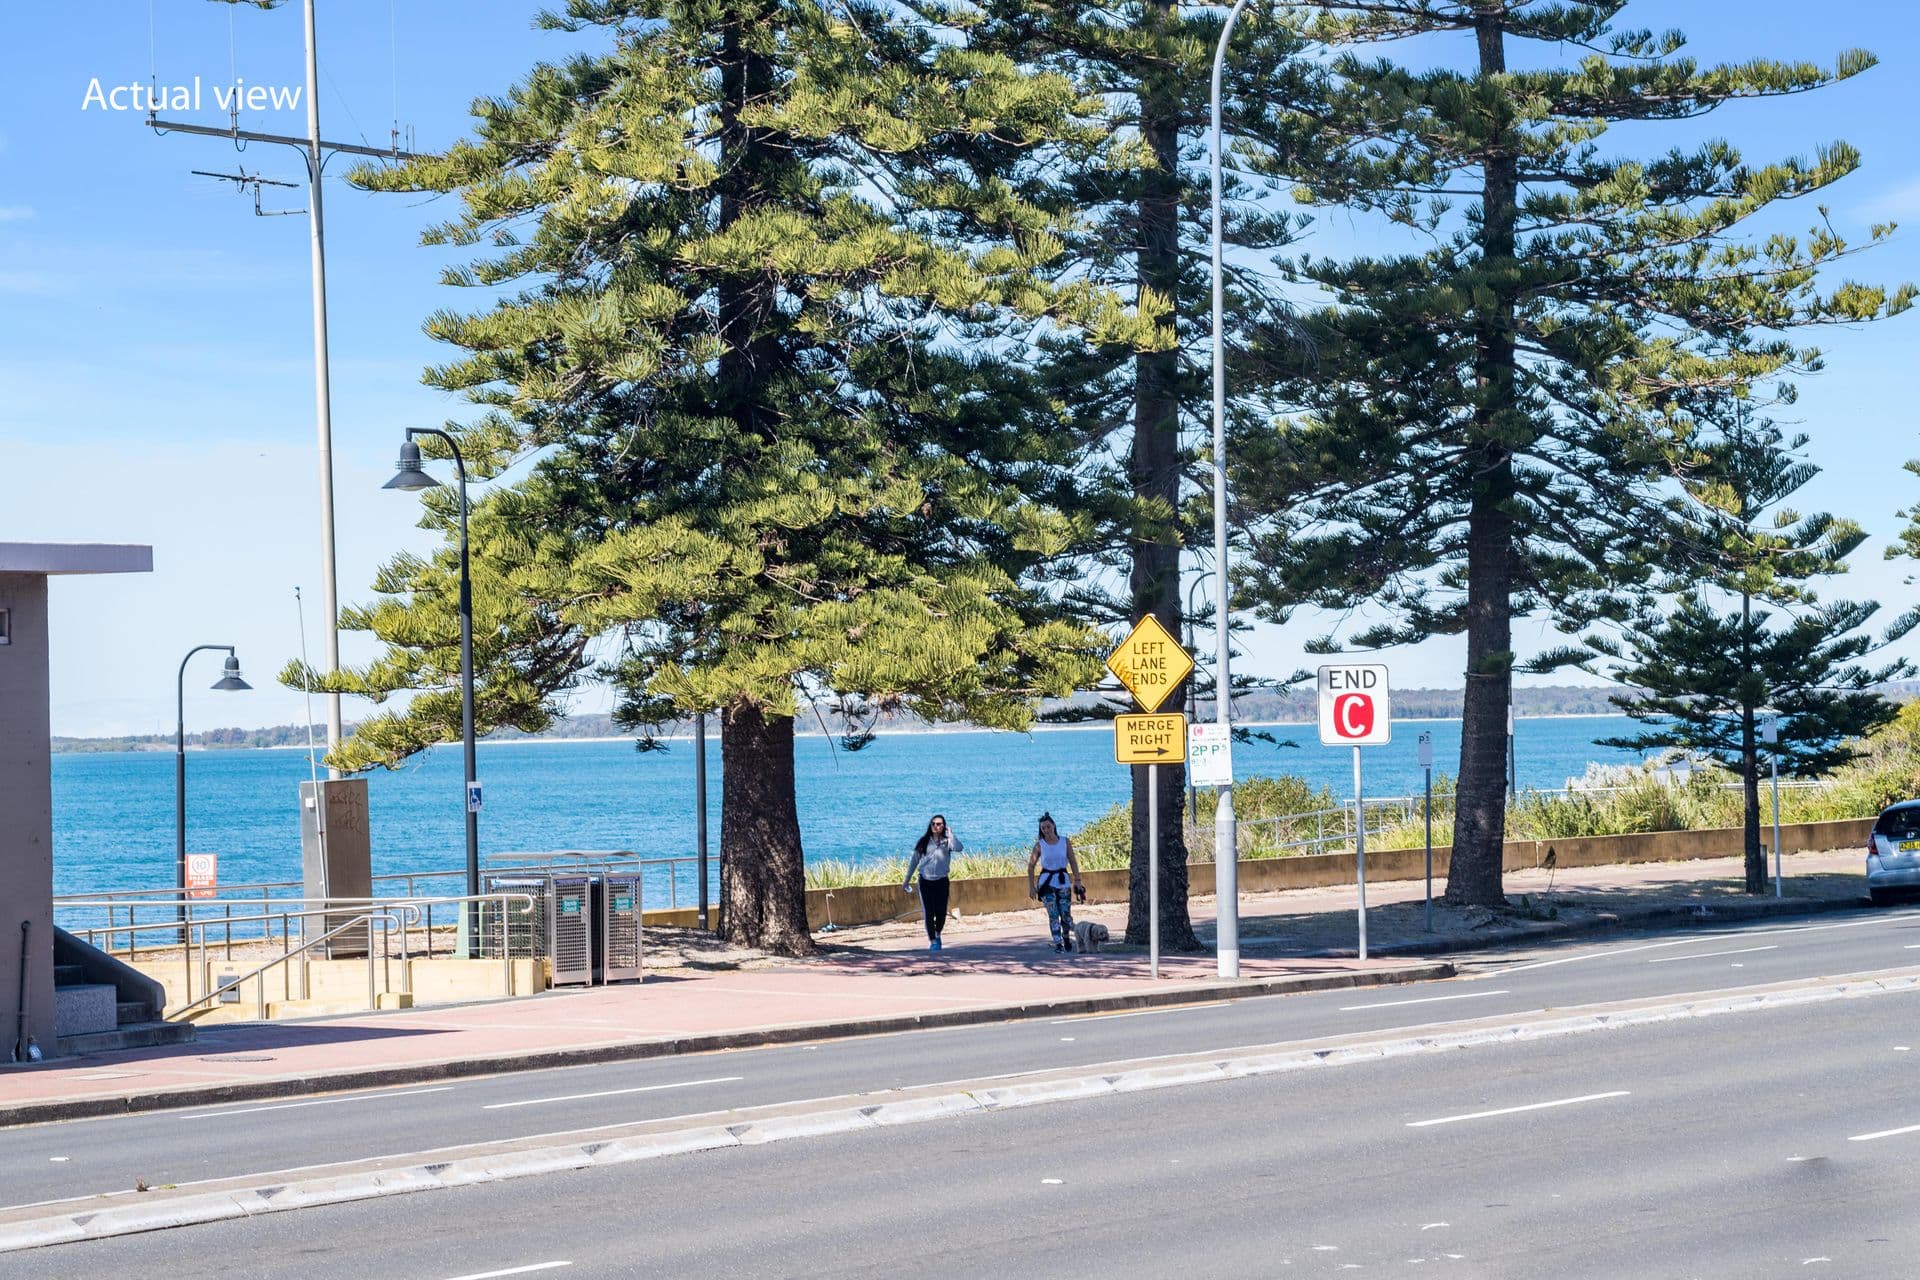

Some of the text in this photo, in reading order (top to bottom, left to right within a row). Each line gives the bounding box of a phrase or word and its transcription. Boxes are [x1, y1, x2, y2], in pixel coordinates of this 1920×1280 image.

[1133, 642, 1165, 655] LEFT
[1132, 657, 1167, 670] LANE
[1132, 672, 1167, 685] ENDS
[1329, 669, 1377, 689] END
[1342, 695, 1366, 736] C
[1127, 720, 1175, 731] MERGE
[1130, 734, 1172, 745] RIGHT
[1191, 745, 1208, 757] 2P
